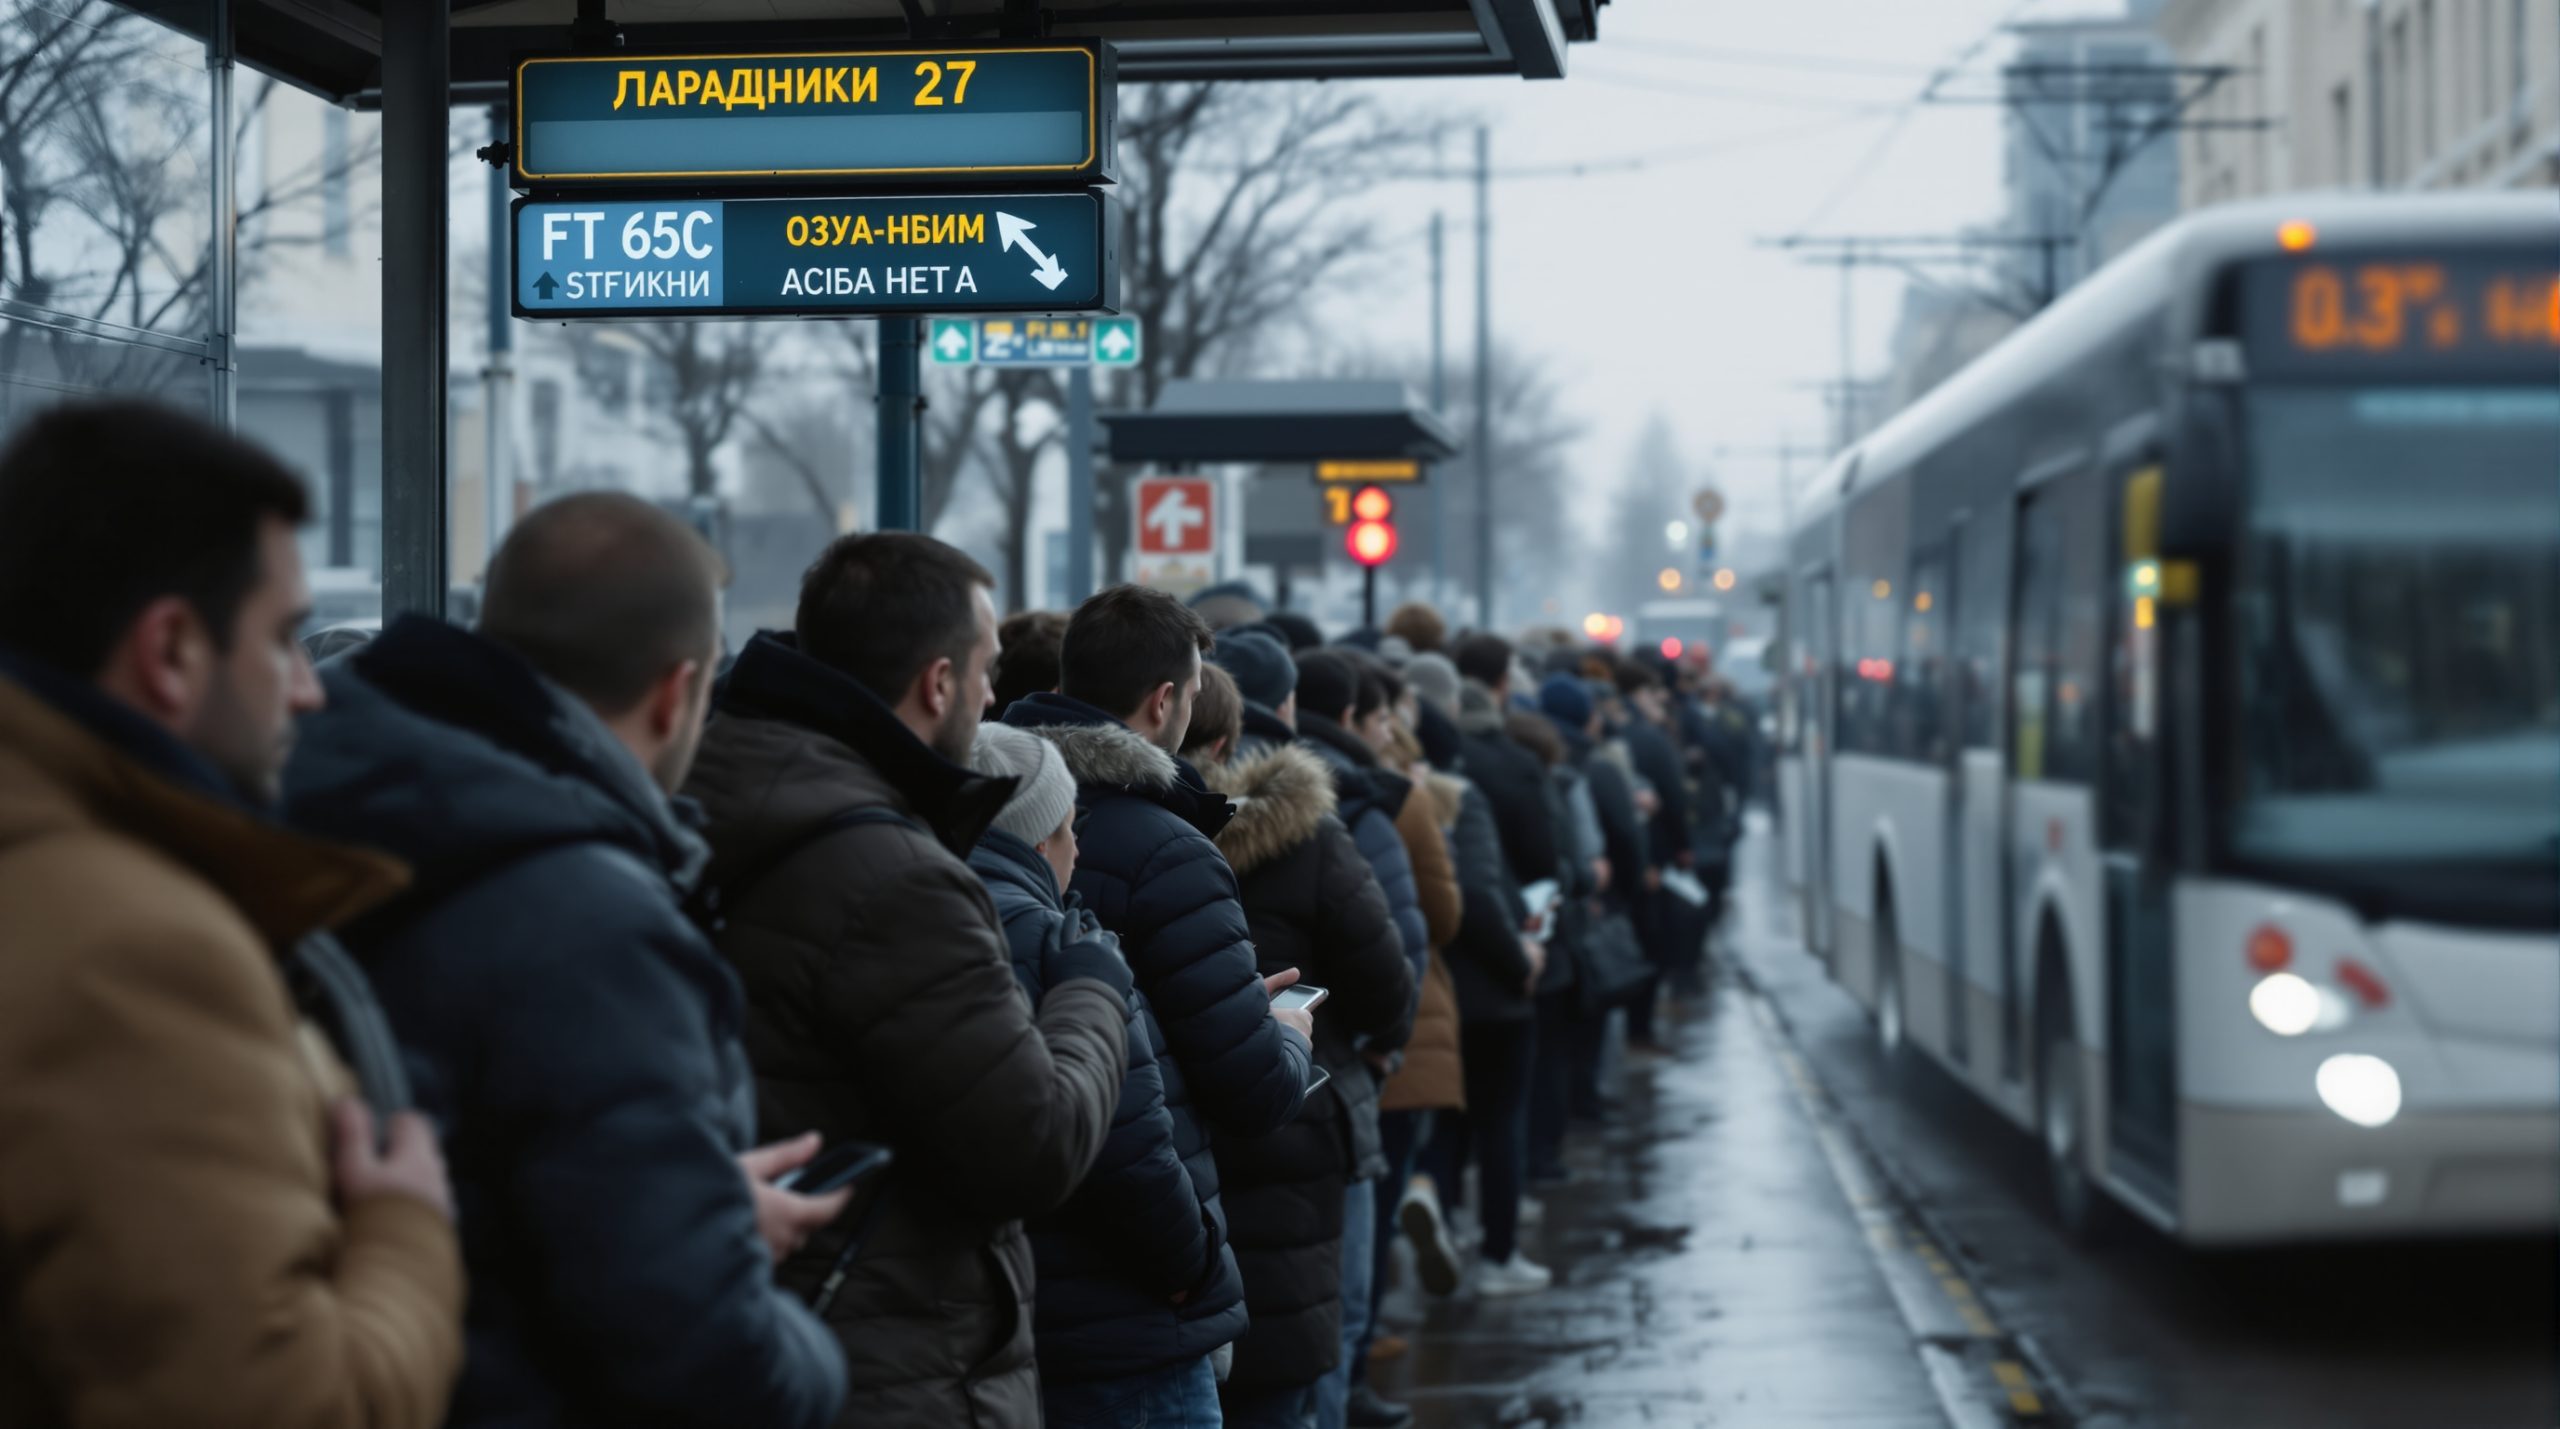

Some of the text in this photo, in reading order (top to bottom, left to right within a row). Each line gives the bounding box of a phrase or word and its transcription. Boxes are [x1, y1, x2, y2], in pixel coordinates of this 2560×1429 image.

[913, 60, 977, 107] 27
[543, 210, 714, 261] FT 65C
